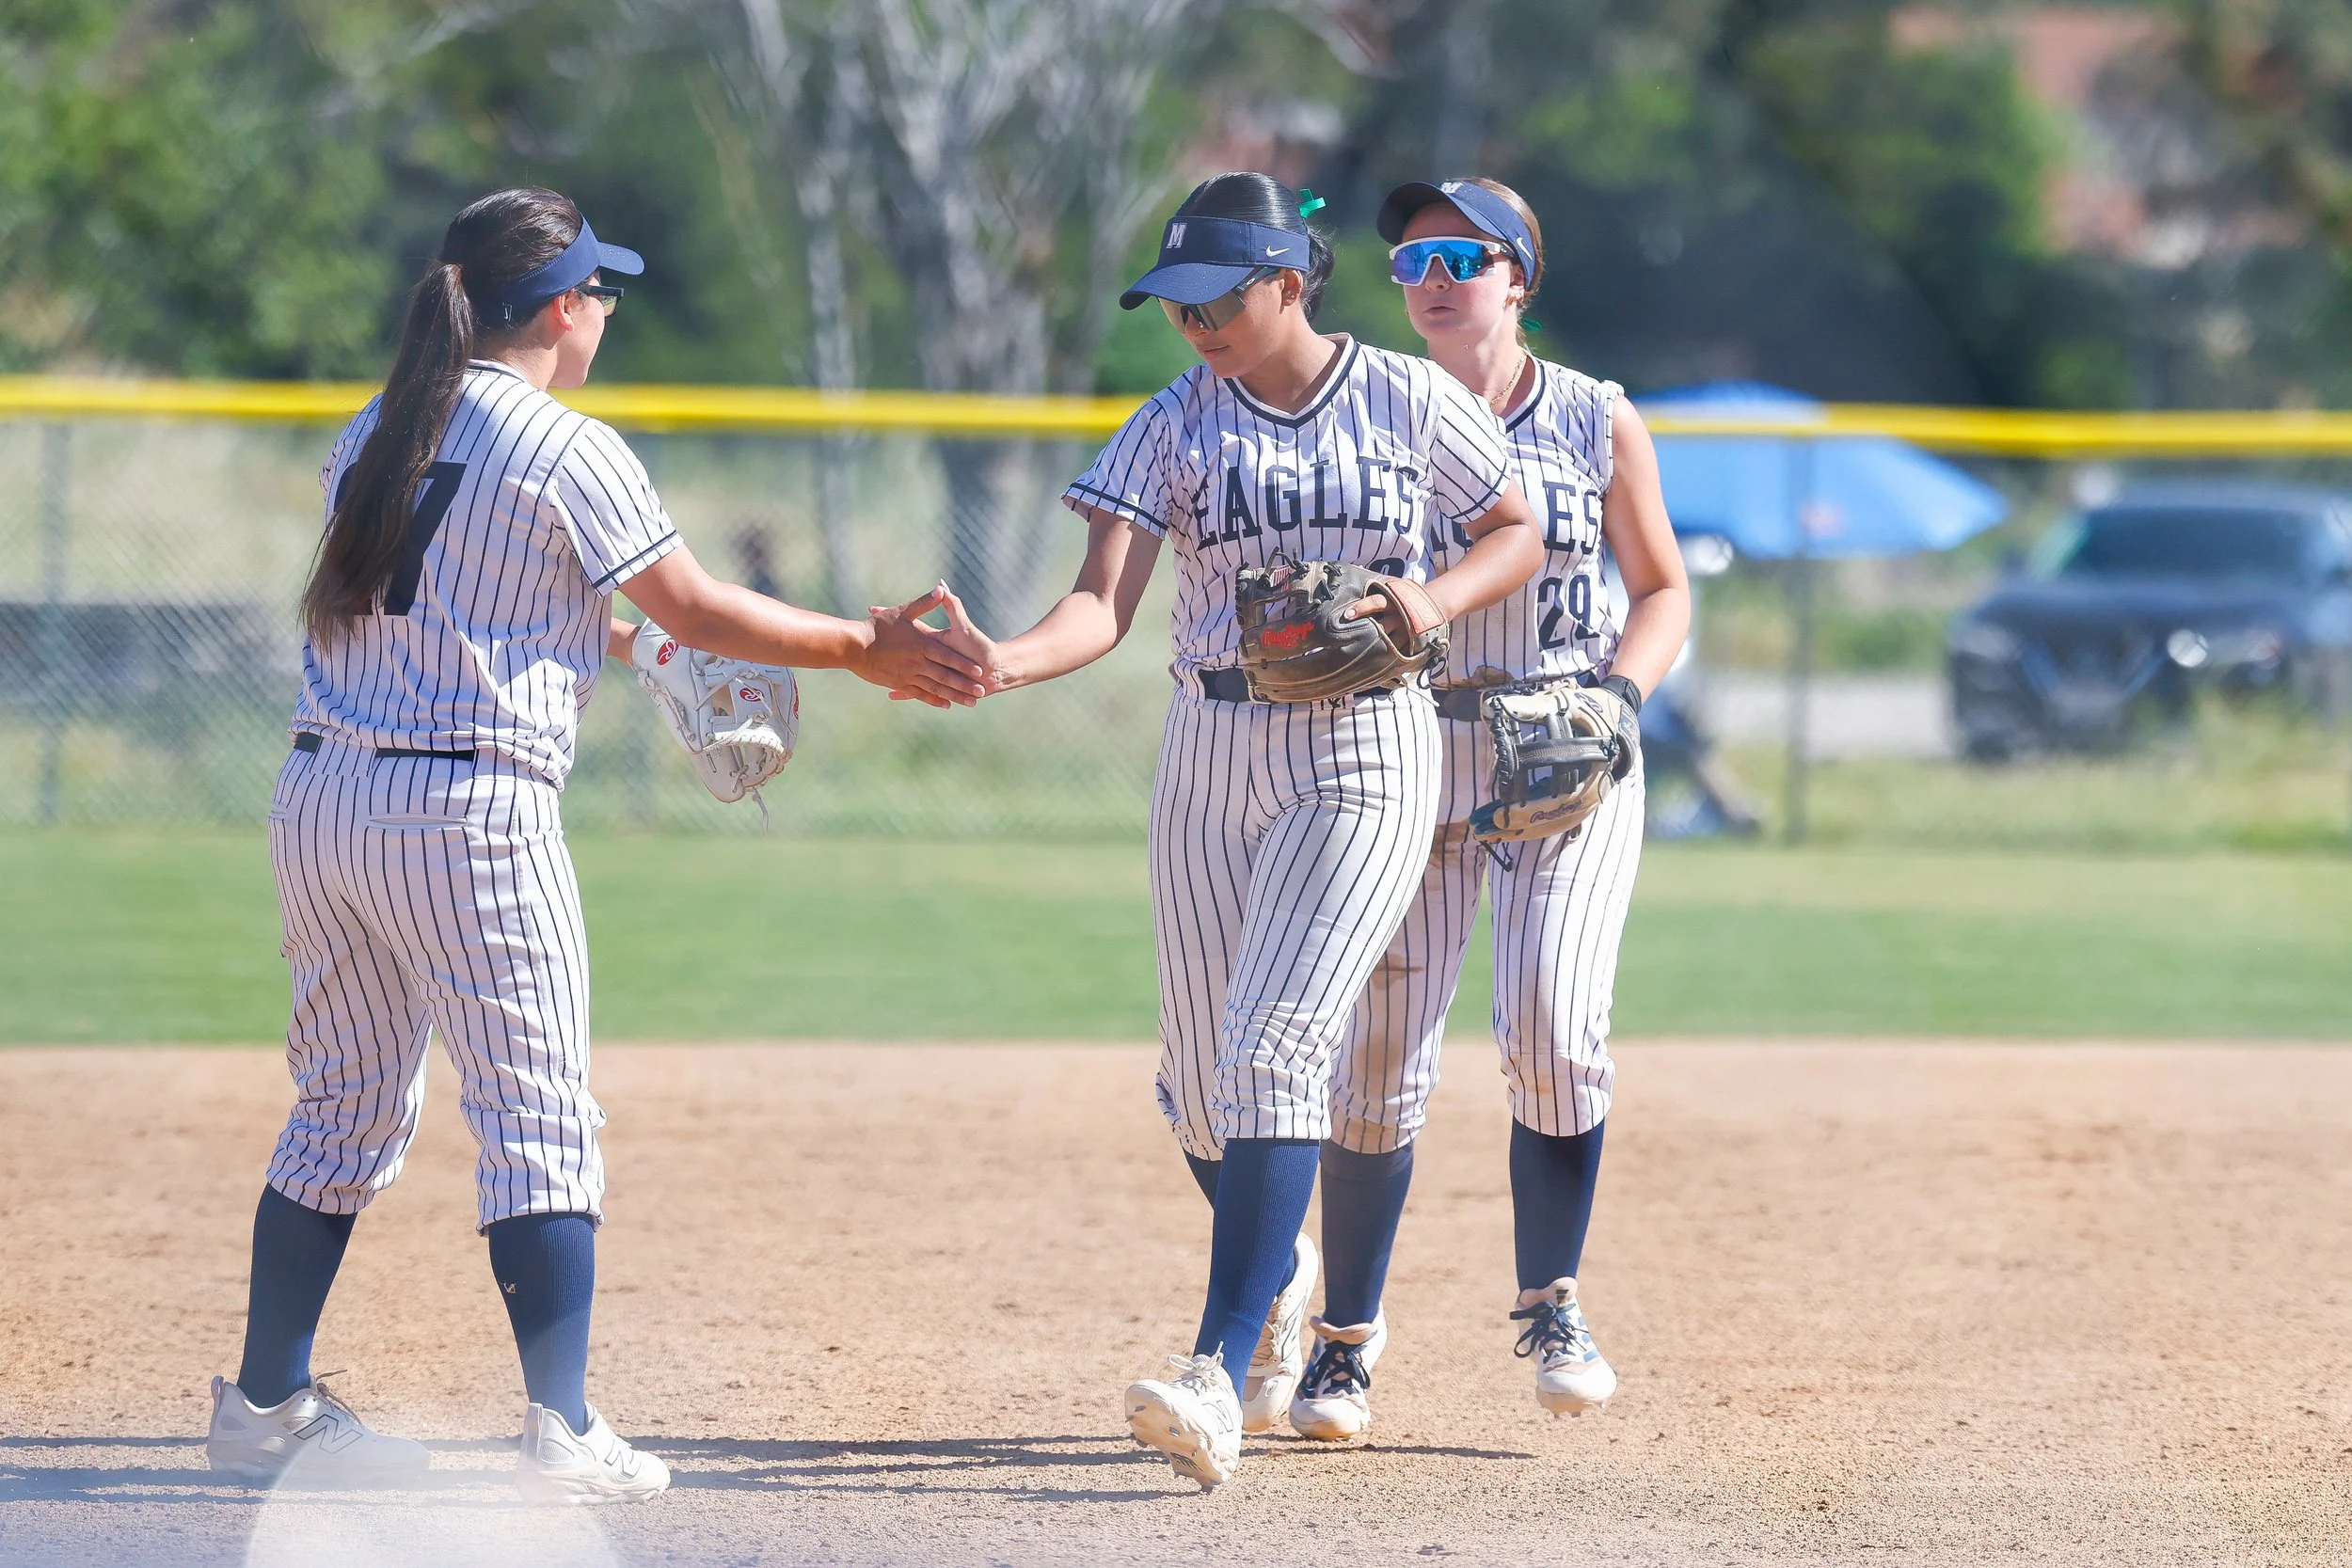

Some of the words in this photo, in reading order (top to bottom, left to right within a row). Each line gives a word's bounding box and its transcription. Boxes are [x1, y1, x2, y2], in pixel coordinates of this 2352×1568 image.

[1167, 222, 1187, 248] M
[1192, 456, 1421, 551] EAGLES
[1537, 575, 1599, 651] 29
